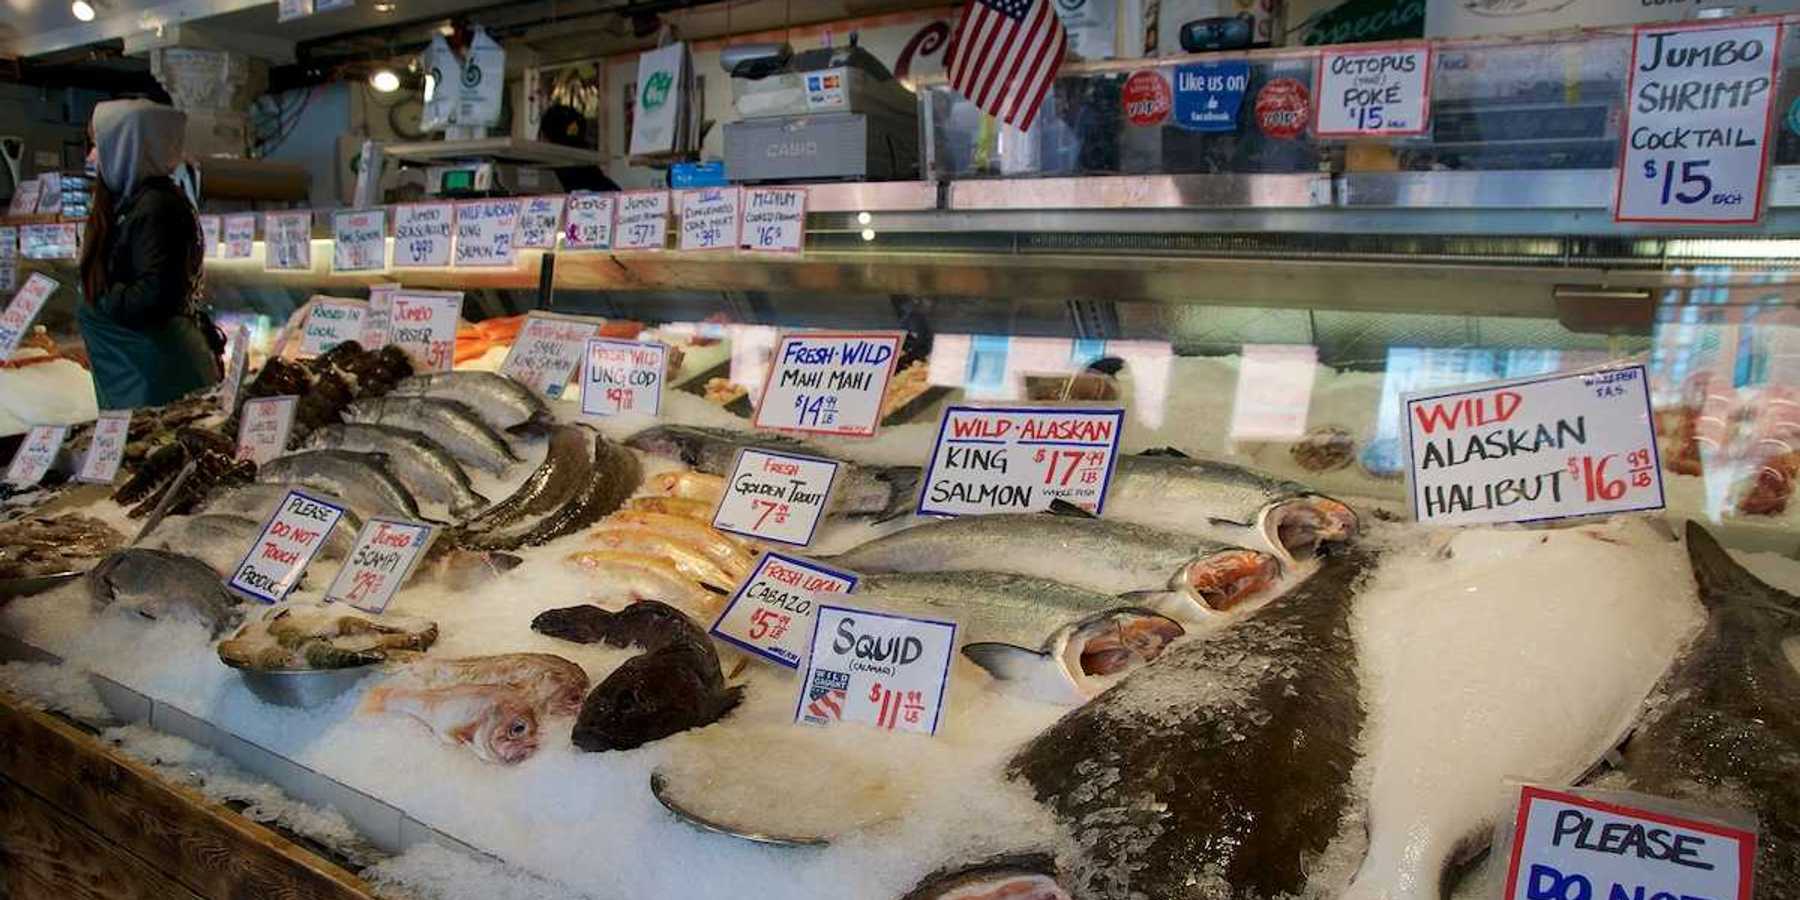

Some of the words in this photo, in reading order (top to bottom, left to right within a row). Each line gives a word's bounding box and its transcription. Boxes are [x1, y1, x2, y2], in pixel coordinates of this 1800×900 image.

[1332, 54, 1417, 75] OCTOPUS
[1641, 32, 1763, 71] JUMBO
[1180, 72, 1205, 91] Like
[1207, 76, 1224, 91] us
[1226, 75, 1245, 91] on
[1637, 77, 1769, 113] SHRIMP
[1632, 126, 1756, 150] COCKTAIL
[1644, 159, 1712, 205] $15
[629, 370, 656, 388] COD
[780, 369, 823, 390] MAHI
[828, 370, 872, 391] MAHI
[1416, 391, 1523, 434] WILD
[953, 418, 1012, 438] WILD
[1020, 418, 1112, 442] ALASKAN
[1422, 416, 1586, 470] ALASKAN
[764, 457, 799, 477] FRESH
[945, 446, 1008, 474] KING
[735, 473, 786, 499] GOLDEN
[788, 480, 821, 506] TROUT
[930, 479, 1033, 508] SALMON
[1424, 468, 1568, 518] HALIBUT
[288, 498, 332, 521] PLEASE
[271, 521, 289, 537] DO
[290, 528, 320, 546] NOT
[261, 541, 300, 566] TOUCH
[762, 561, 804, 587] FRESH
[747, 582, 811, 616] CABAZO
[833, 617, 923, 665] SQUID
[1552, 809, 1715, 871] PLEASE
